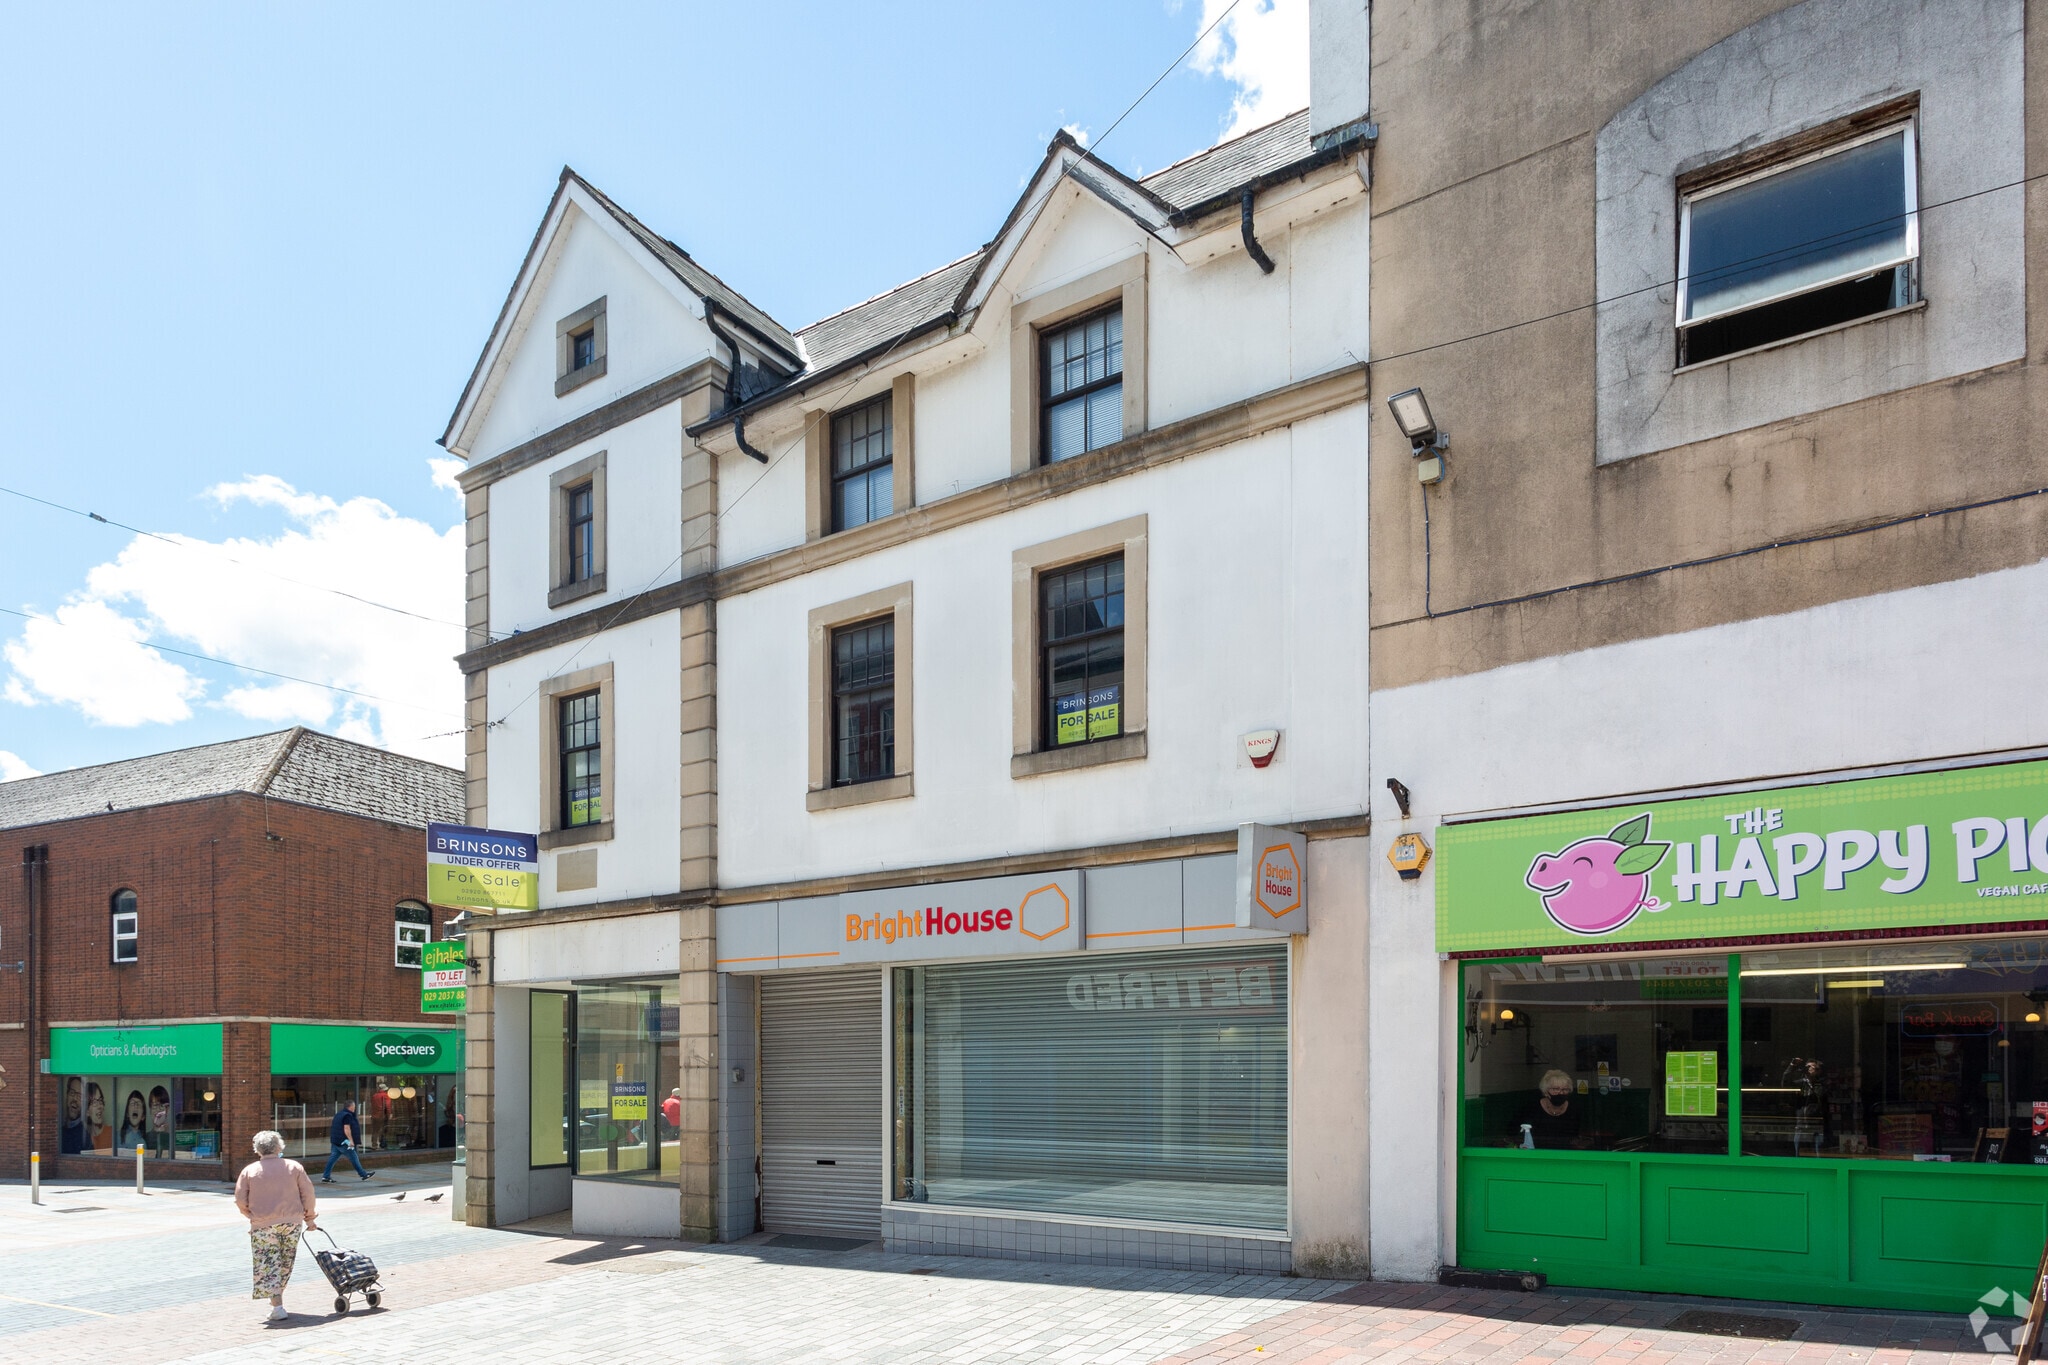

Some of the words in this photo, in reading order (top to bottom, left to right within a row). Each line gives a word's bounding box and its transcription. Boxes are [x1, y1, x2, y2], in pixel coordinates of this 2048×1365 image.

[1062, 692, 1112, 709] BRINSONS
[1060, 716, 1083, 728] FOR
[1088, 709, 1115, 723] SALE
[1248, 738, 1272, 746] KINGS
[575, 786, 600, 798] BRINON
[574, 803, 588, 812] FOR
[1724, 807, 1784, 834] THE
[437, 838, 527, 858] BRINSONS
[447, 856, 483, 867] UNDER
[486, 860, 520, 870] OFFER
[1672, 824, 1930, 905] HAPPY
[448, 870, 474, 883] For
[483, 874, 520, 887] Sale
[1266, 863, 1292, 881] Bright
[1266, 880, 1292, 896] House
[1976, 884, 2020, 898] VEGAN
[457, 895, 511, 904] brinsons.co.uk
[846, 907, 1013, 944] BrightHouse
[426, 946, 464, 969] ejhales
[436, 972, 446, 981] TO
[449, 971, 463, 980] LET
[424, 992, 437, 1000] 029
[438, 991, 455, 1000] 2037
[456, 990, 466, 1000] 88
[90, 1045, 122, 1058] Opticians
[124, 1044, 129, 1056] &
[131, 1044, 177, 1058] Audiologists
[374, 1042, 435, 1057] Specsavers
